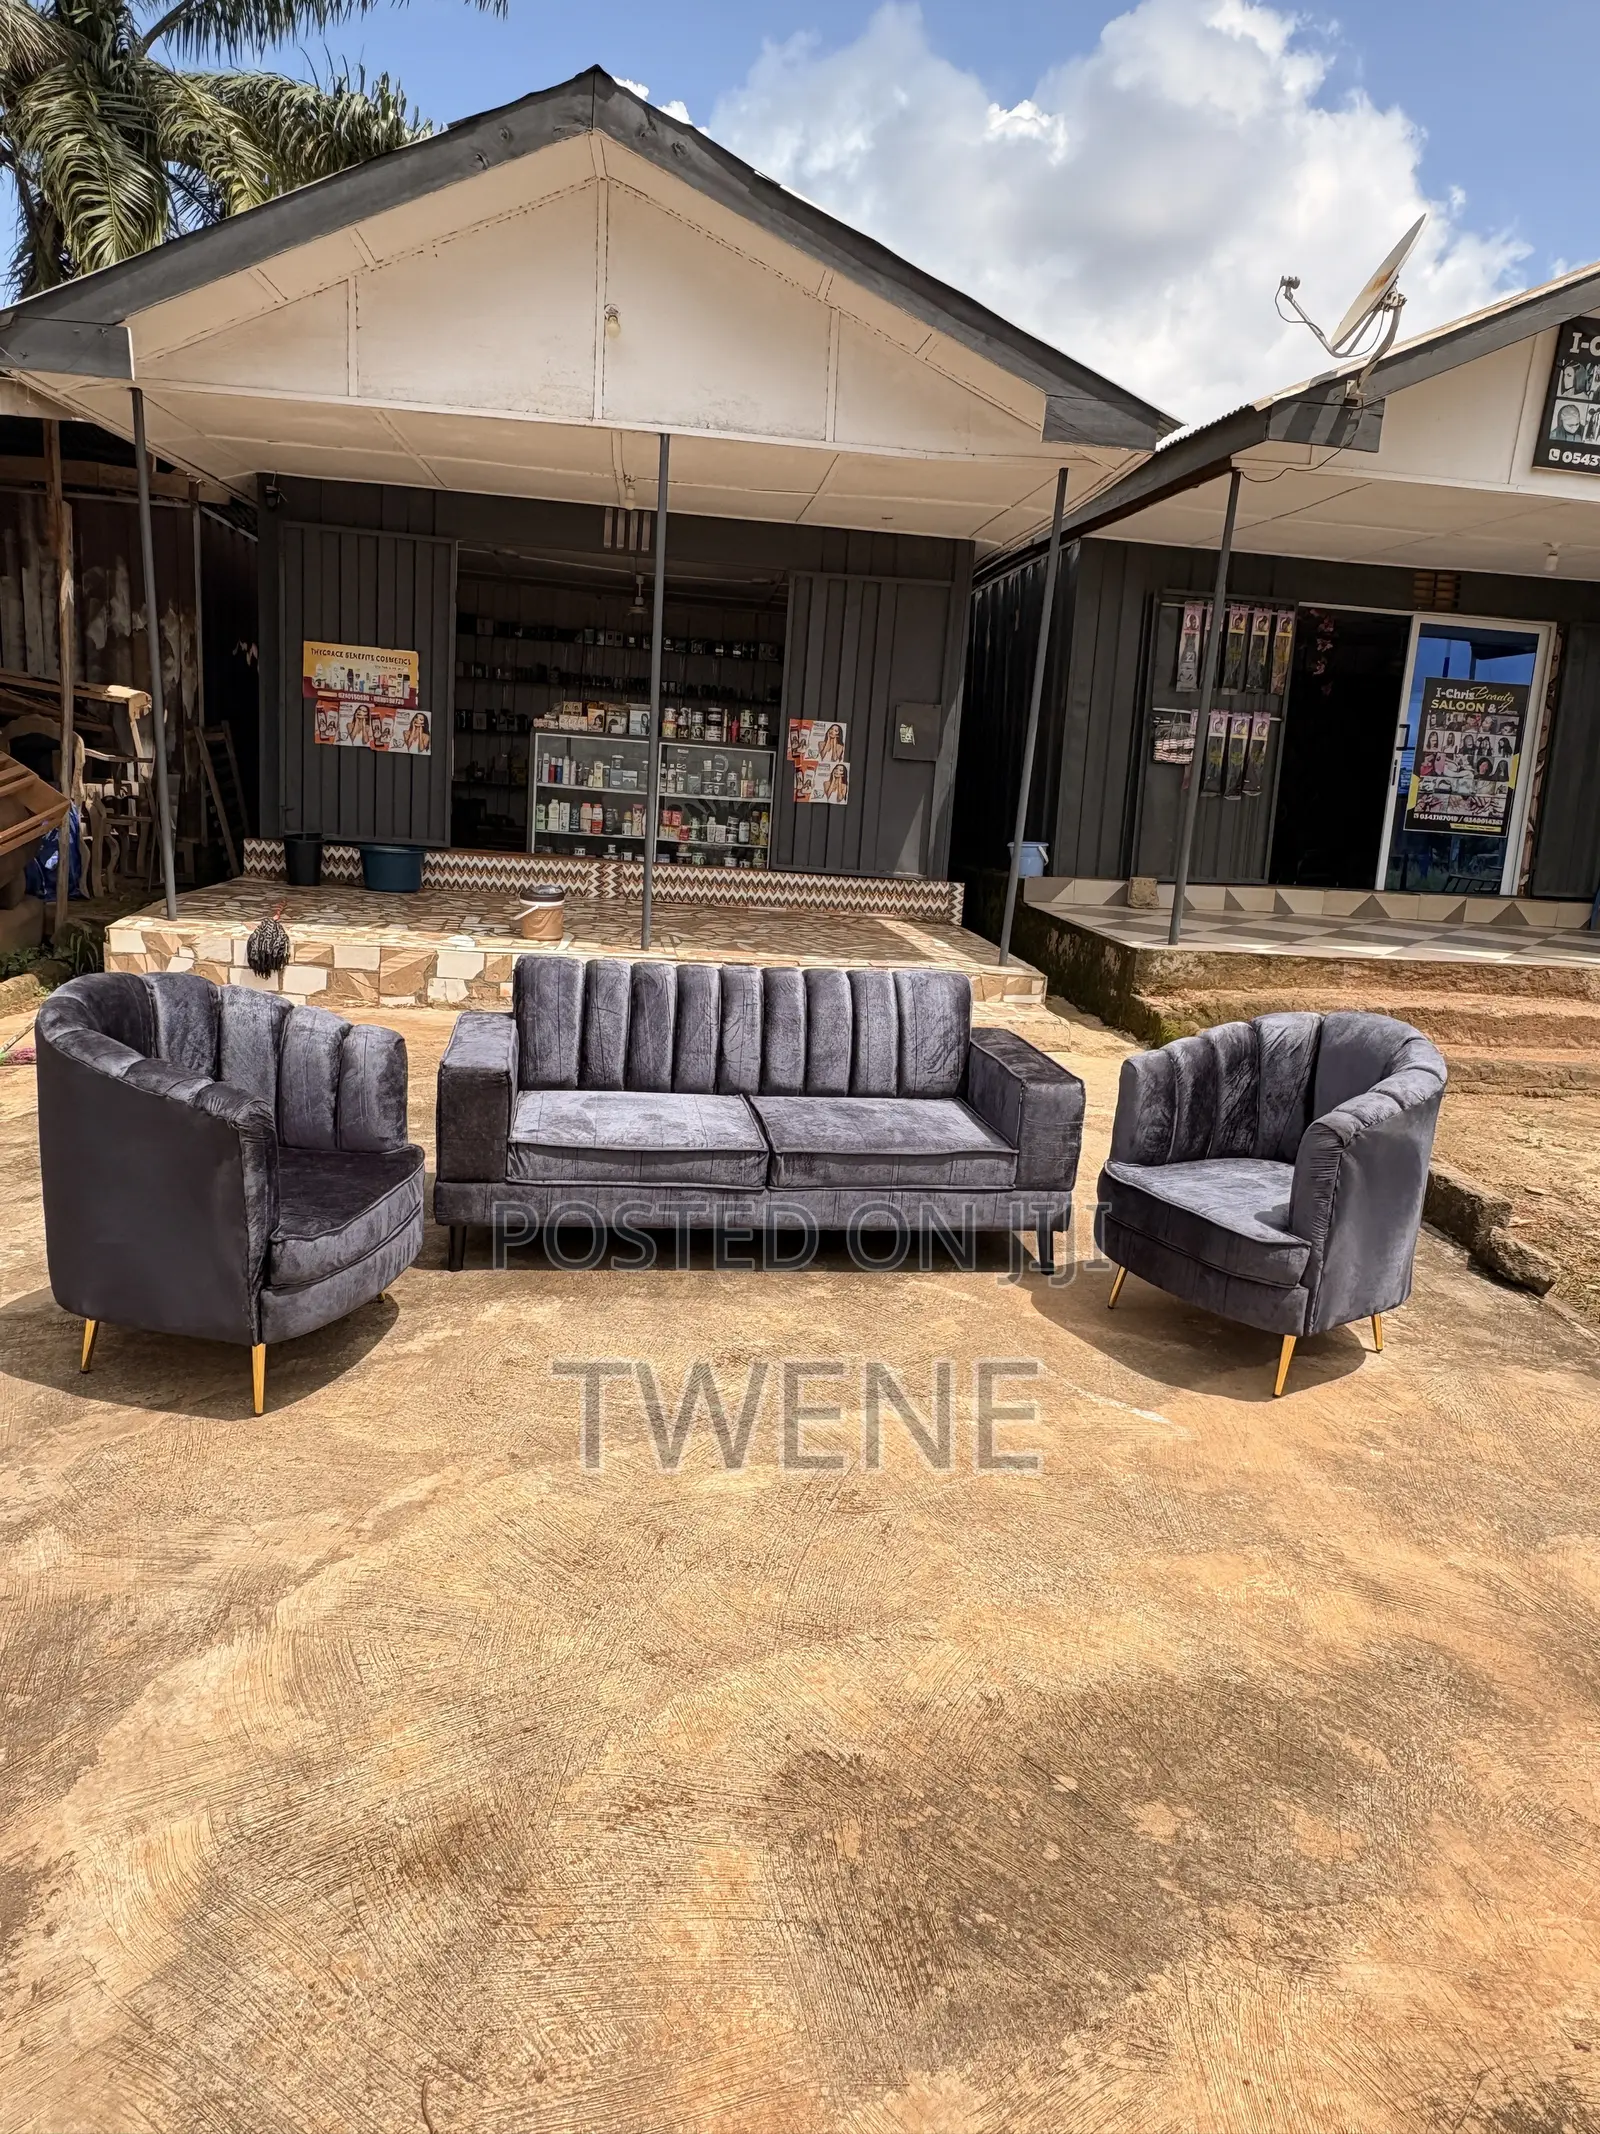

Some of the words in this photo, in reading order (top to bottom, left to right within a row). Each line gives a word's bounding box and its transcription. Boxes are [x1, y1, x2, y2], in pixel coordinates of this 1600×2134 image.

[1562, 451, 1600, 467] 0543
[376, 655, 411, 665] COSMETICS
[1435, 687, 1475, 700] I-Chris
[1431, 700, 1485, 713] SALOON
[1488, 704, 1496, 714] &
